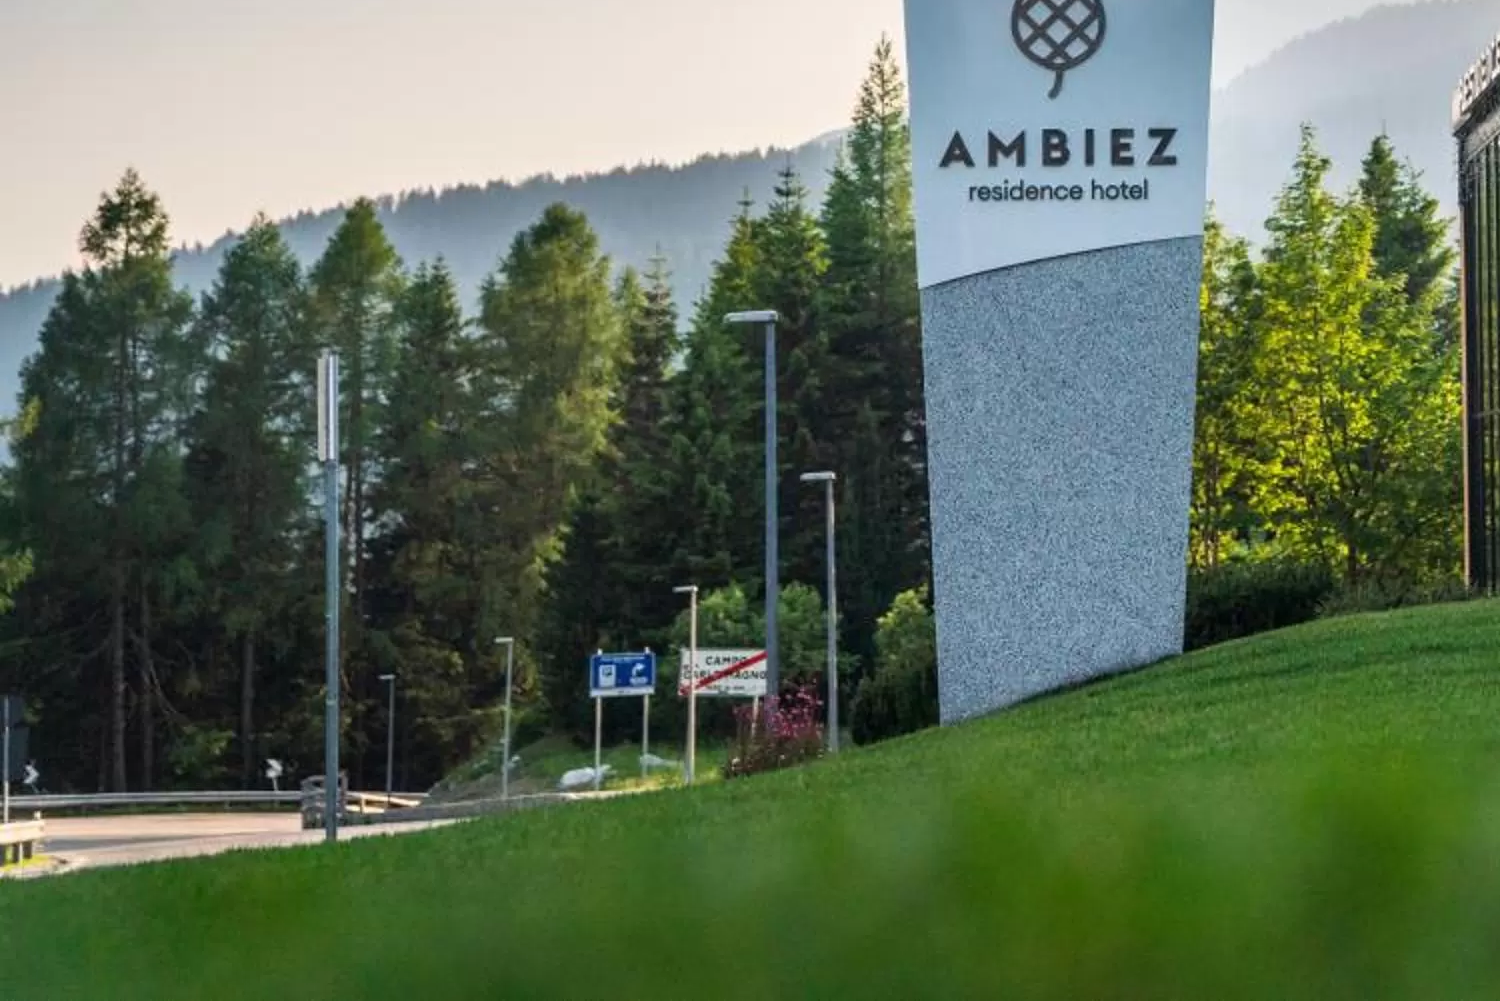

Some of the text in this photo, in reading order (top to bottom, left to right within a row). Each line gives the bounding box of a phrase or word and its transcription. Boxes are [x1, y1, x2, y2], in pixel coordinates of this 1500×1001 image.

[938, 128, 1178, 168] AMBIEZ
[968, 178, 1149, 201] residence hotel
